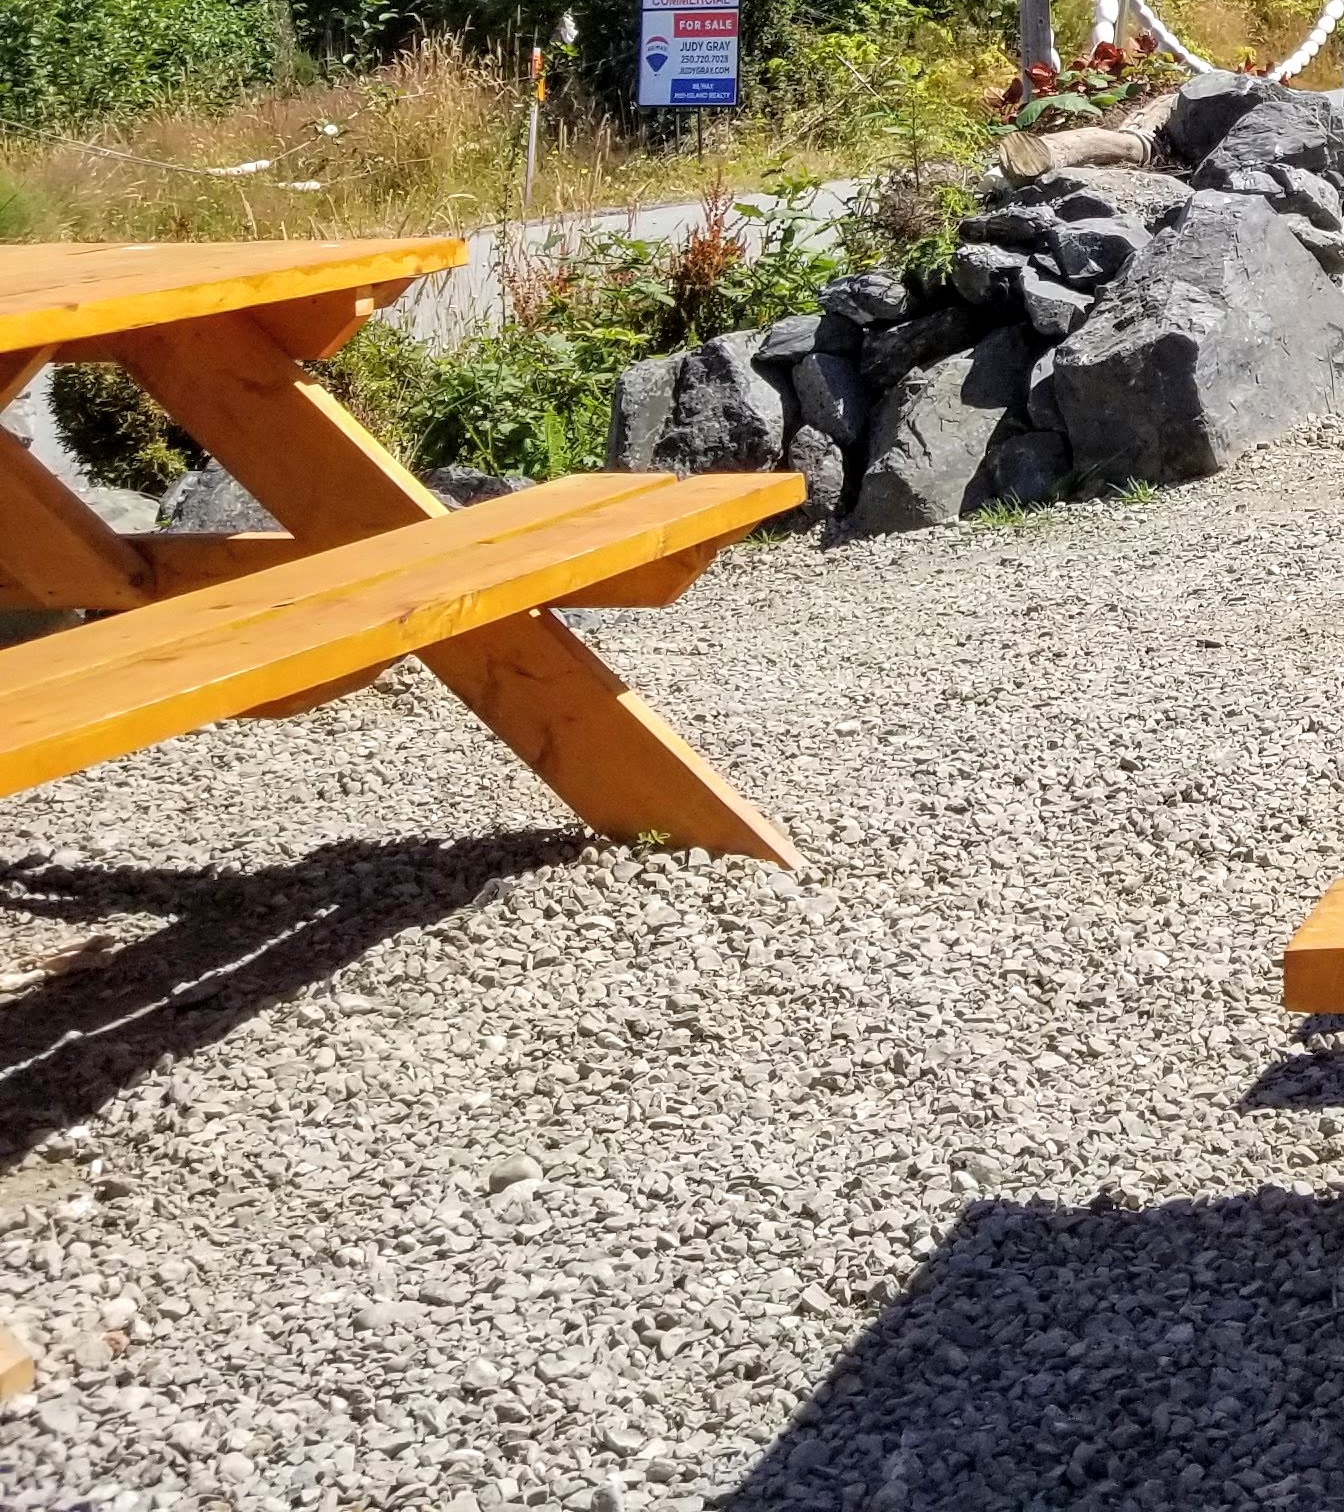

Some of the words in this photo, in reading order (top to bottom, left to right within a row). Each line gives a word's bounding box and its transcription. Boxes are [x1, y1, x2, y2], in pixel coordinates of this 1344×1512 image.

[679, 20, 701, 30] FOR
[704, 20, 732, 30] SALE
[679, 41, 703, 52] JUDY
[706, 41, 731, 51] GRAY
